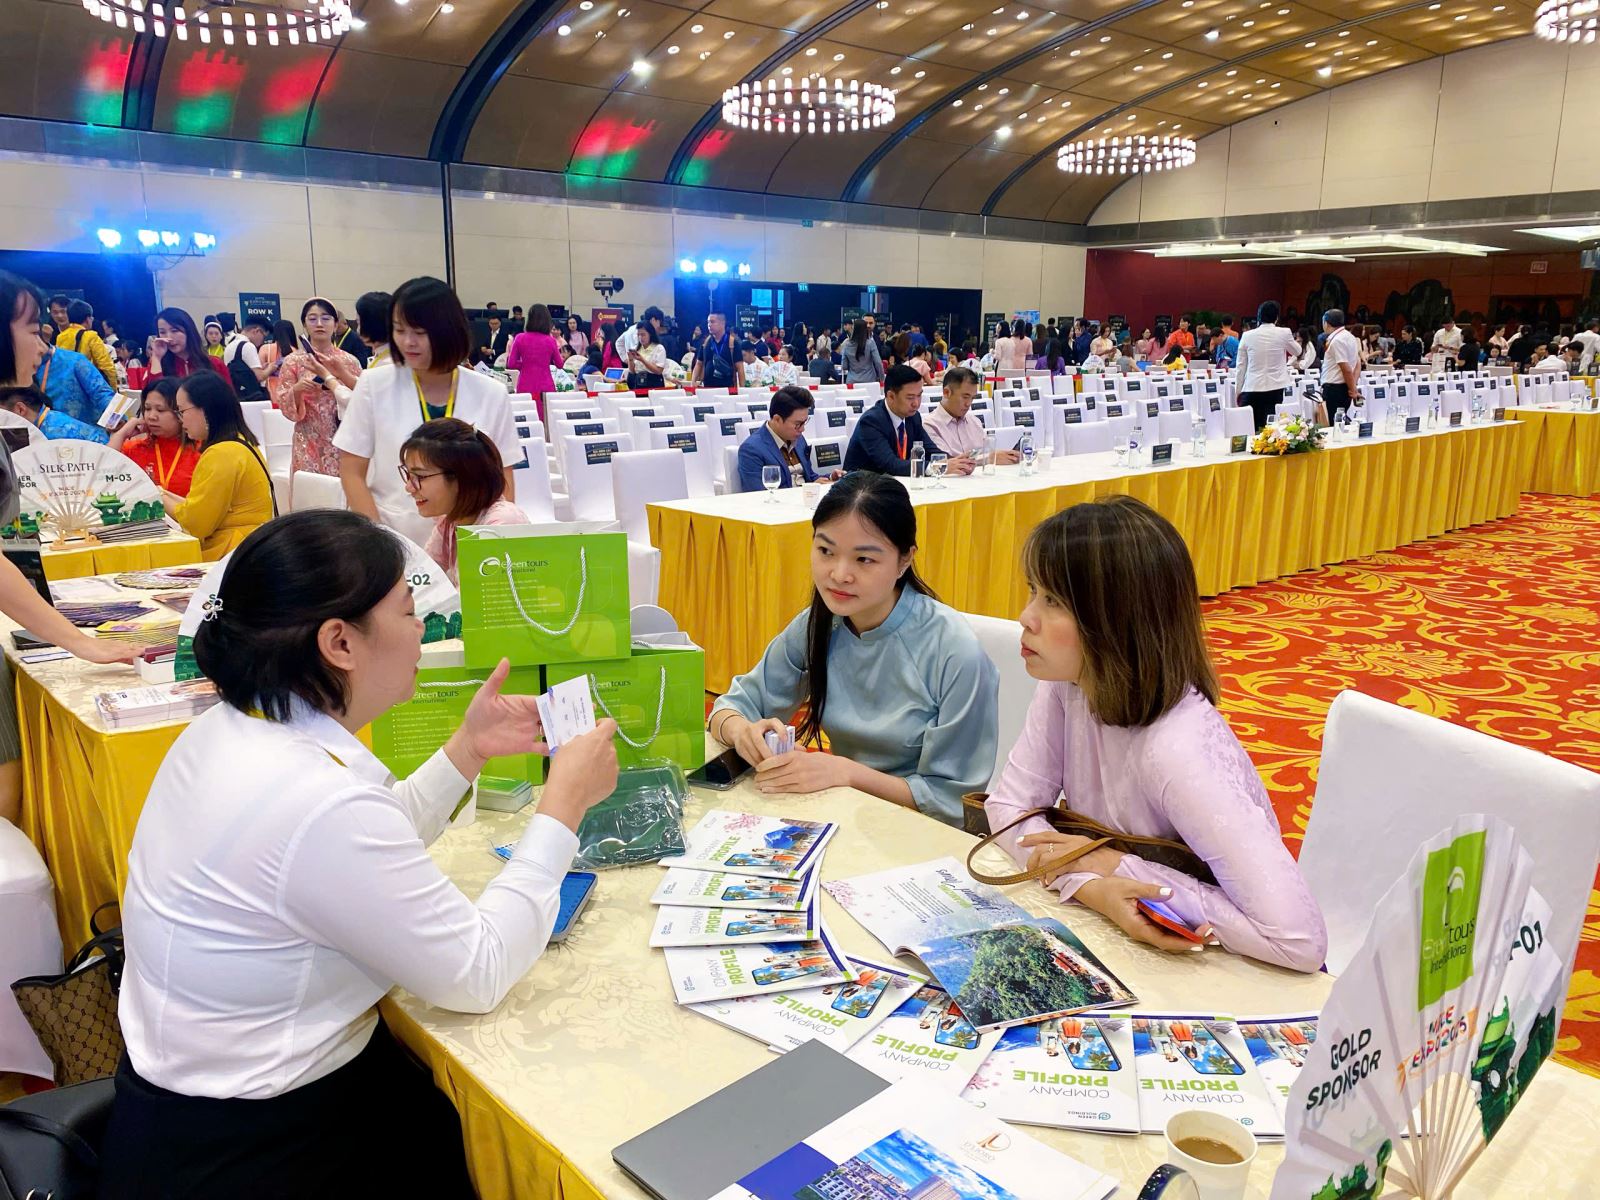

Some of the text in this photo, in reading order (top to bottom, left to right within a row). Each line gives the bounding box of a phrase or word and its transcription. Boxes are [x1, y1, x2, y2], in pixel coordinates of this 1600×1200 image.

[40, 463, 95, 473] SILK PATH
[105, 474, 132, 482] M-03
[709, 836, 741, 861] PROFILE
[703, 872, 726, 896] PROFIL
[704, 907, 723, 935] PROFIL
[720, 948, 747, 986] PROFILE
[774, 994, 848, 1028] PROFILE
[775, 1009, 836, 1036] COMPANY
[872, 1033, 959, 1062] PROFILE
[1330, 1028, 1372, 1070] GOLD
[879, 1051, 951, 1072] COMPANY
[1013, 1069, 1109, 1086] PROFILE
[1140, 1078, 1239, 1092] PROFILE
[1306, 1049, 1382, 1111] SPONSOR
[1029, 1085, 1110, 1099] COMPANY
[1163, 1093, 1244, 1104] COMPANY
